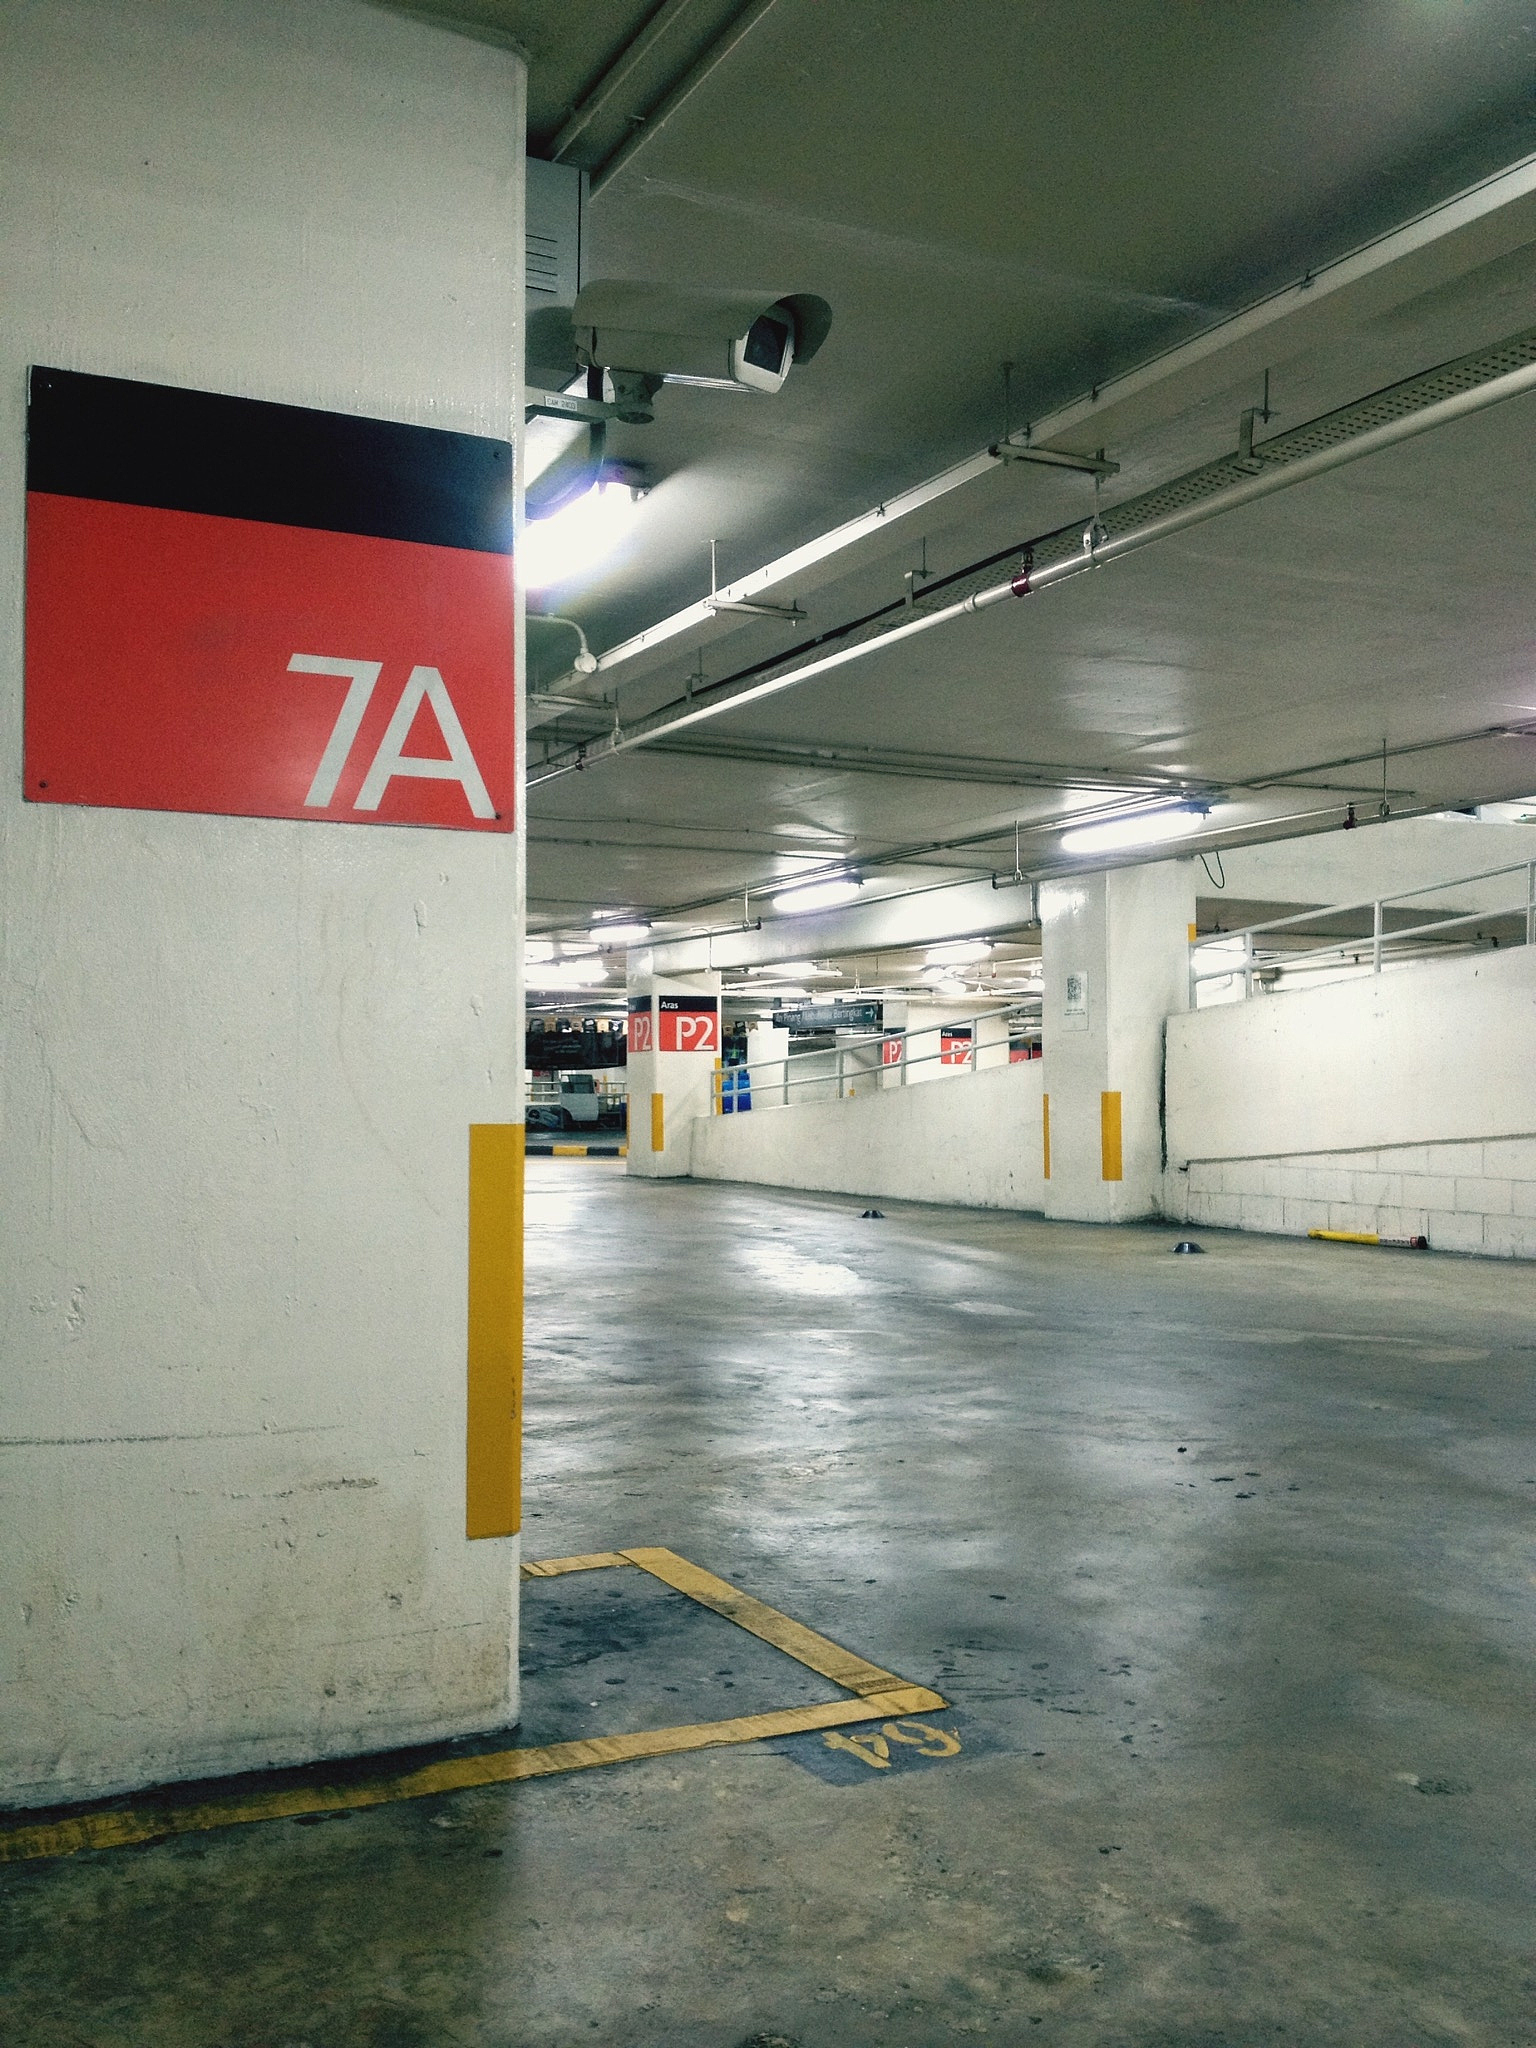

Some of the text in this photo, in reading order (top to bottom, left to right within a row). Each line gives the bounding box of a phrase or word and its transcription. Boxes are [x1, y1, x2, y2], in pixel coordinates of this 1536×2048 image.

[286, 653, 497, 820] 7A
[660, 1001, 679, 1009] Aras
[634, 1016, 652, 1051] P2
[676, 1016, 715, 1051] P2
[951, 1041, 972, 1064] P2
